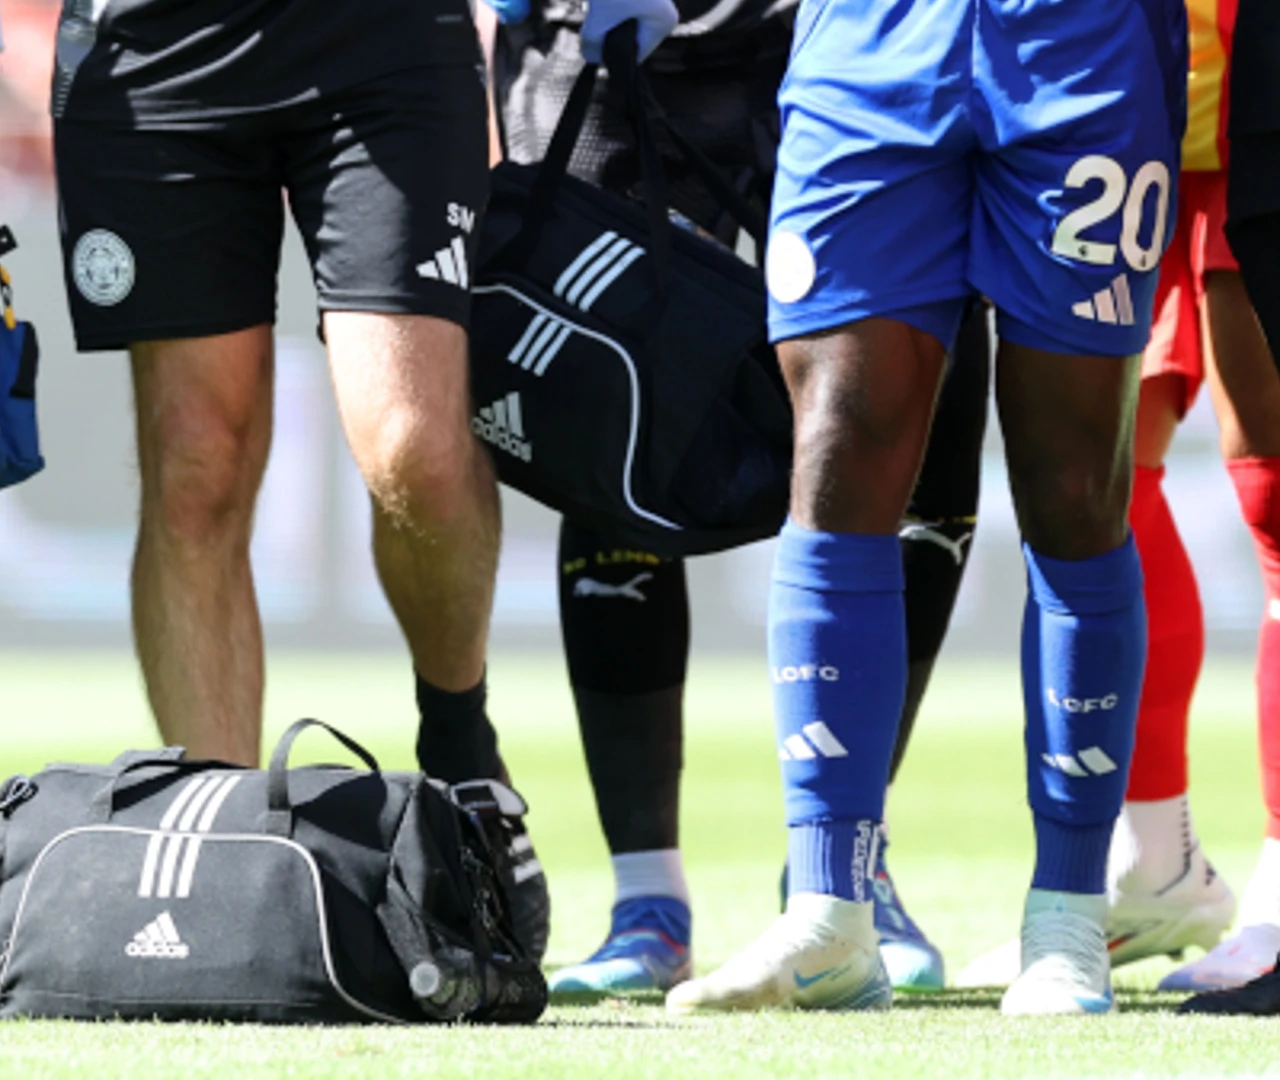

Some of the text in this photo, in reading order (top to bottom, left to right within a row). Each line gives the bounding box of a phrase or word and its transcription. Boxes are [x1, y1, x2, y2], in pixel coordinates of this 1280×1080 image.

[1051, 154, 1170, 272] 20
[469, 416, 533, 464] adidas
[123, 941, 190, 959] adidas
